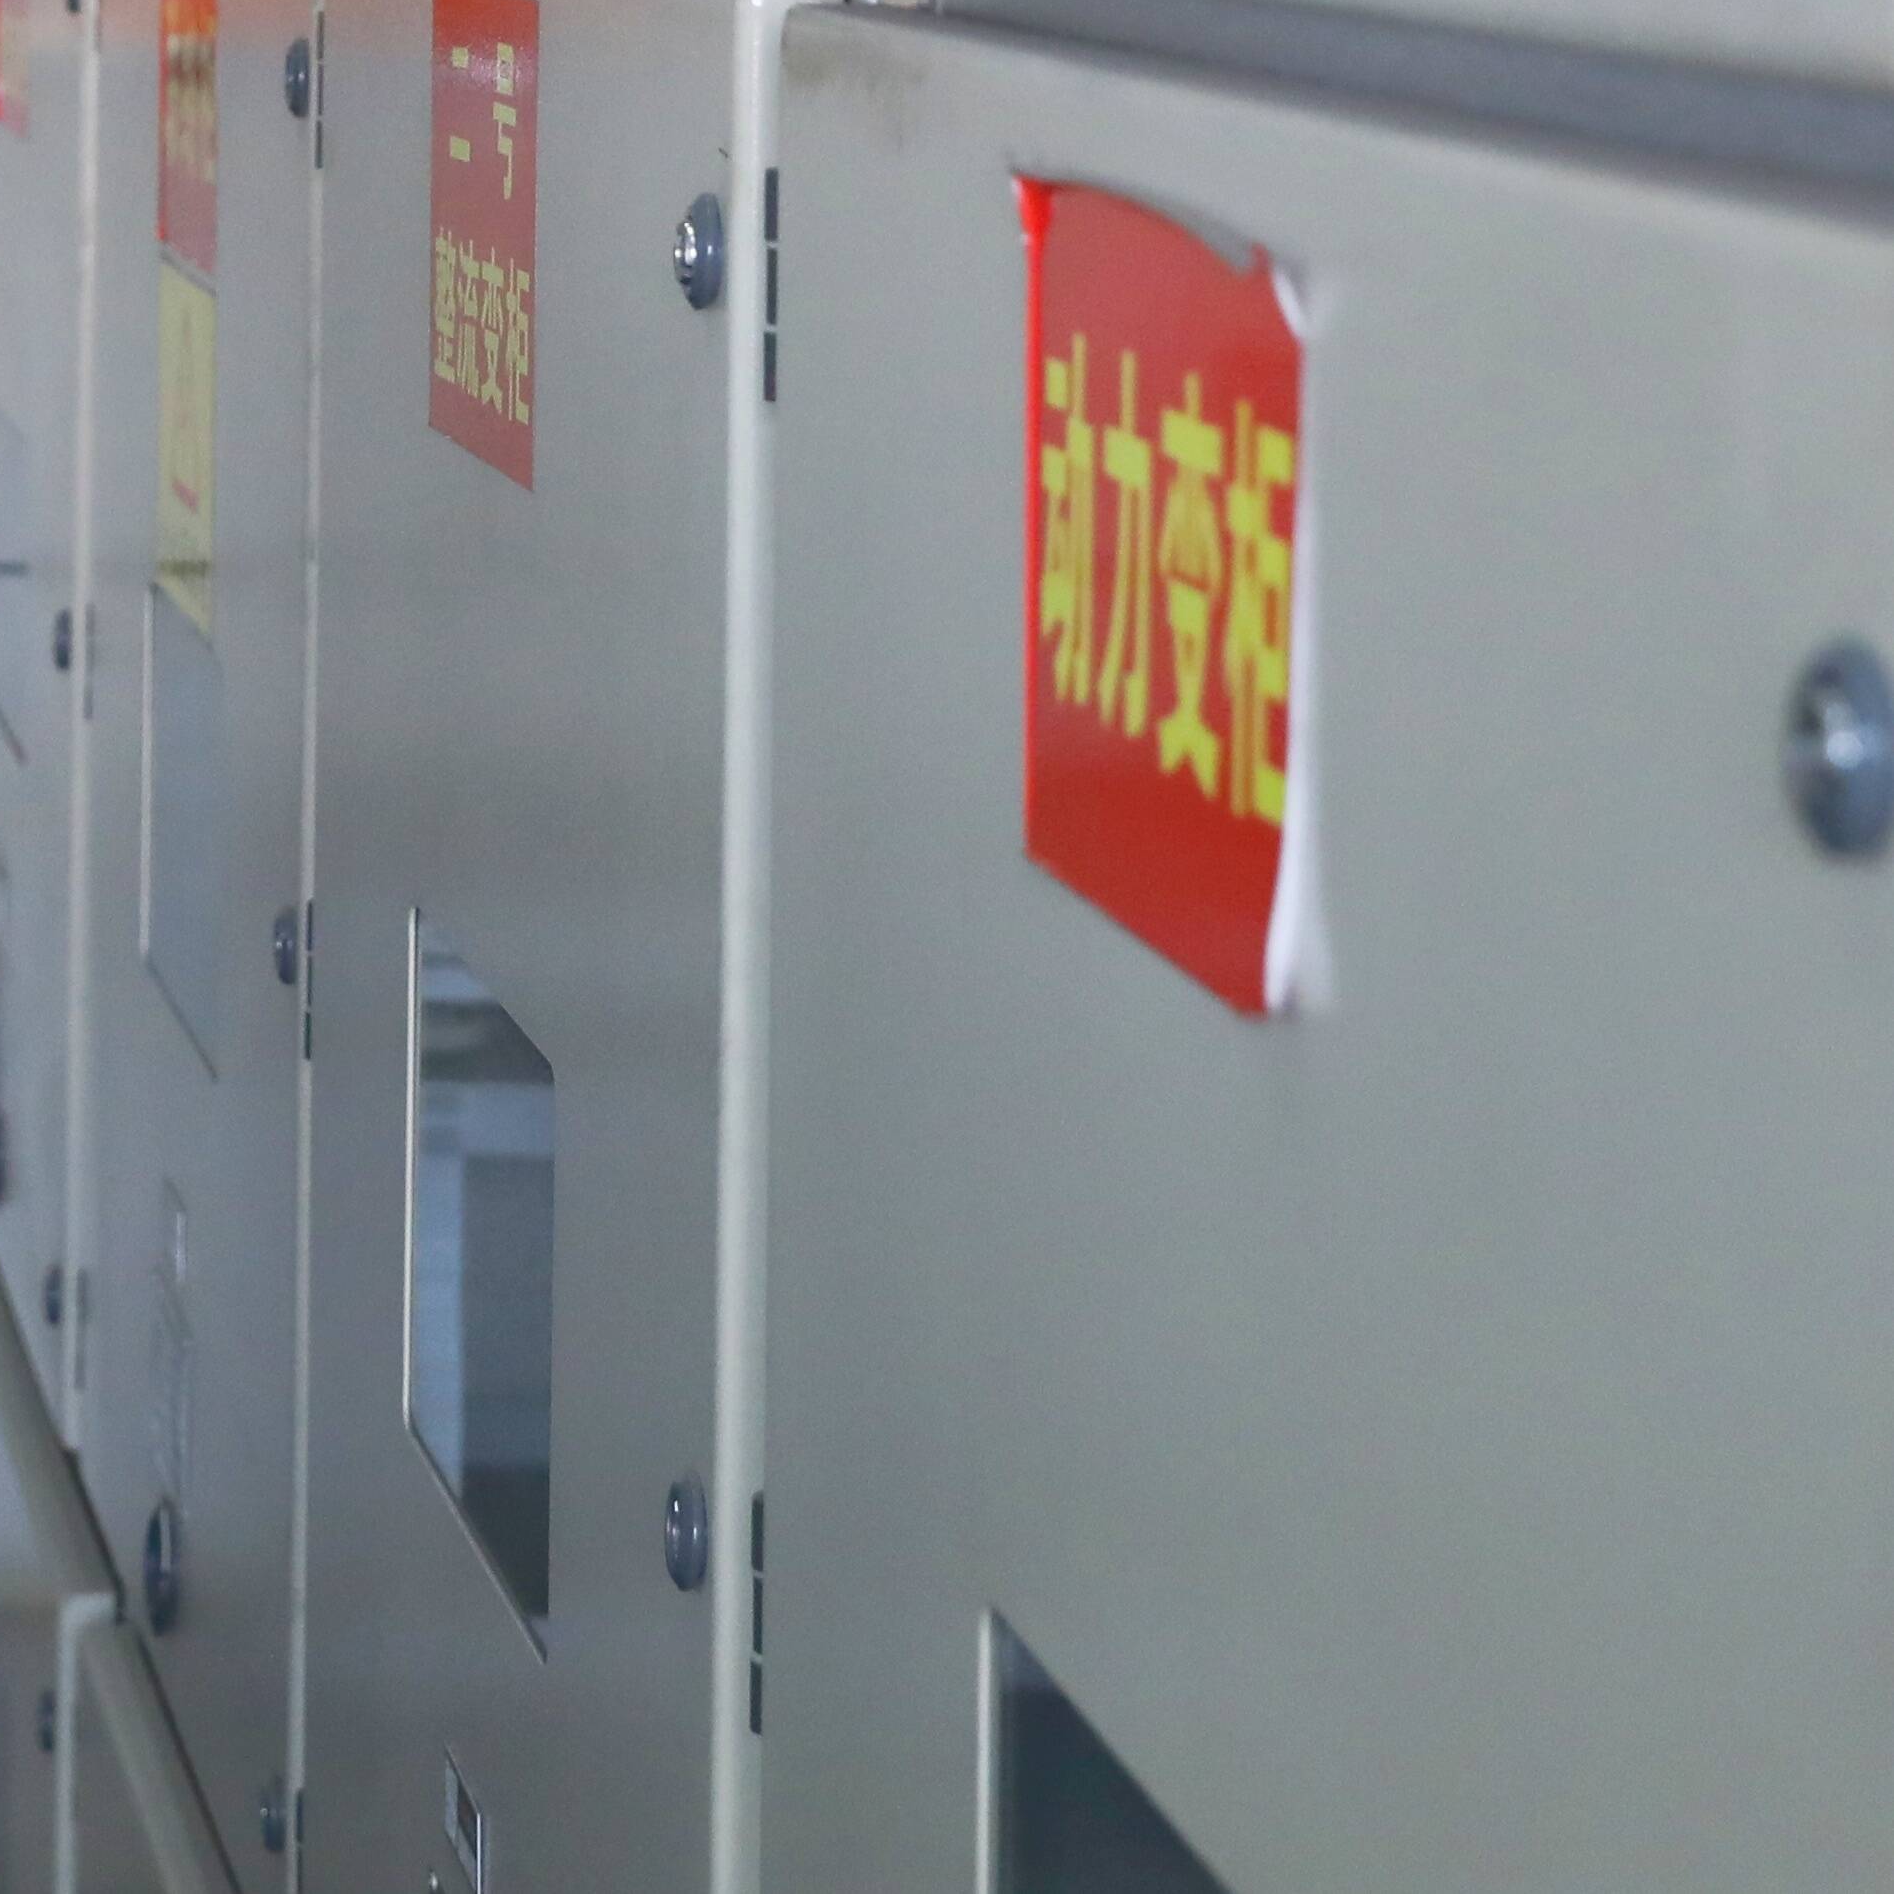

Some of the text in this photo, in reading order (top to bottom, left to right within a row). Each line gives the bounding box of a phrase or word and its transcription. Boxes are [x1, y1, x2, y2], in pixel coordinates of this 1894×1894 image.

[432, 225, 530, 426] 整流变柜
[1040, 330, 1296, 828] 动力变柜
